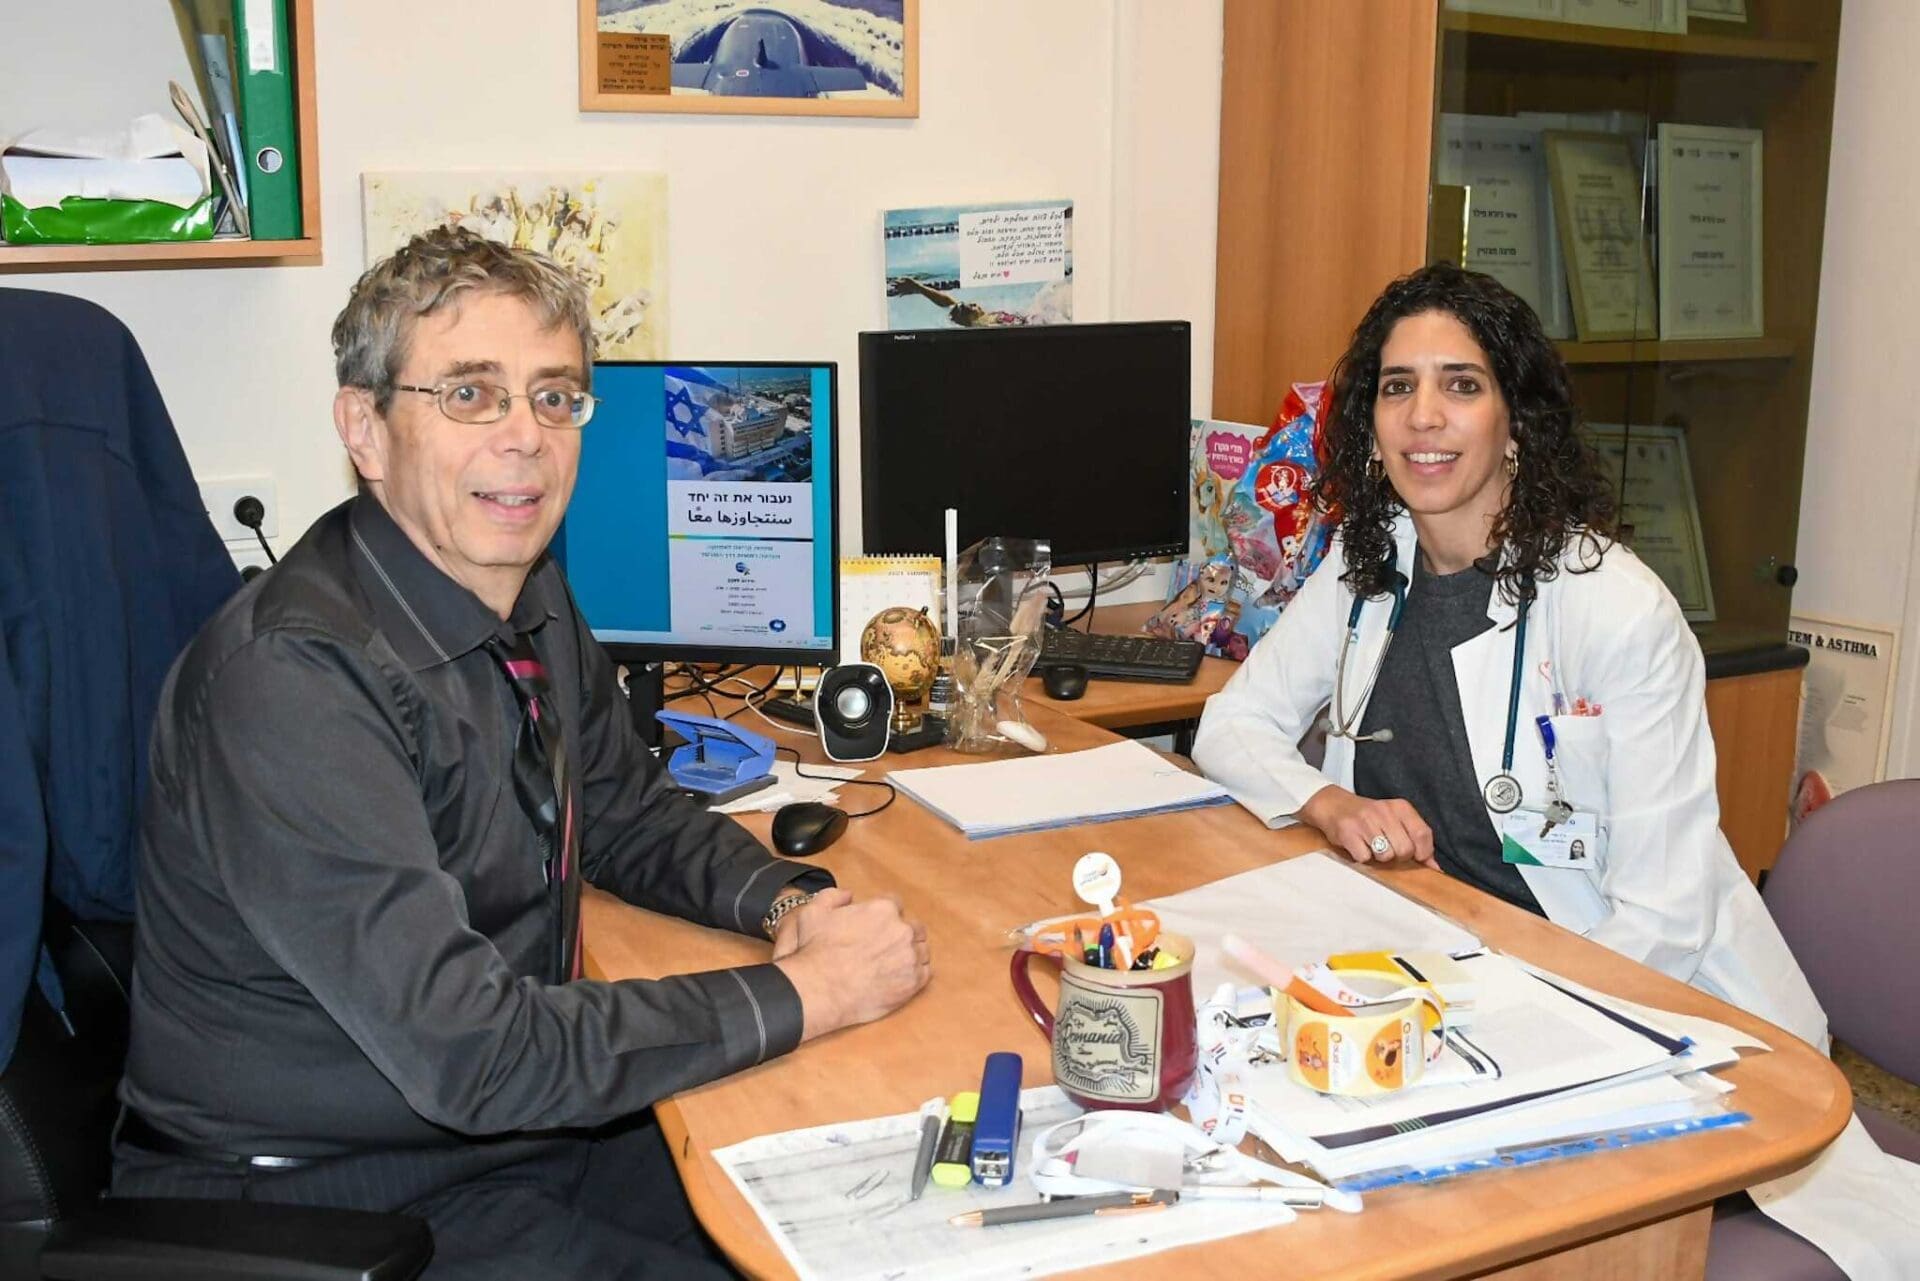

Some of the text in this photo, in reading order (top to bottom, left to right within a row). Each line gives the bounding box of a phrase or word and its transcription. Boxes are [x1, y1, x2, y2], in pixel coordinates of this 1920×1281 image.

[687, 492, 792, 503] נעבור את זה יחד
[717, 510, 792, 527] سنتجاوزها
[1815, 634, 1824, 647] &
[1826, 637, 1877, 656] ASTHMA
[1061, 1022, 1122, 1048] Romania
